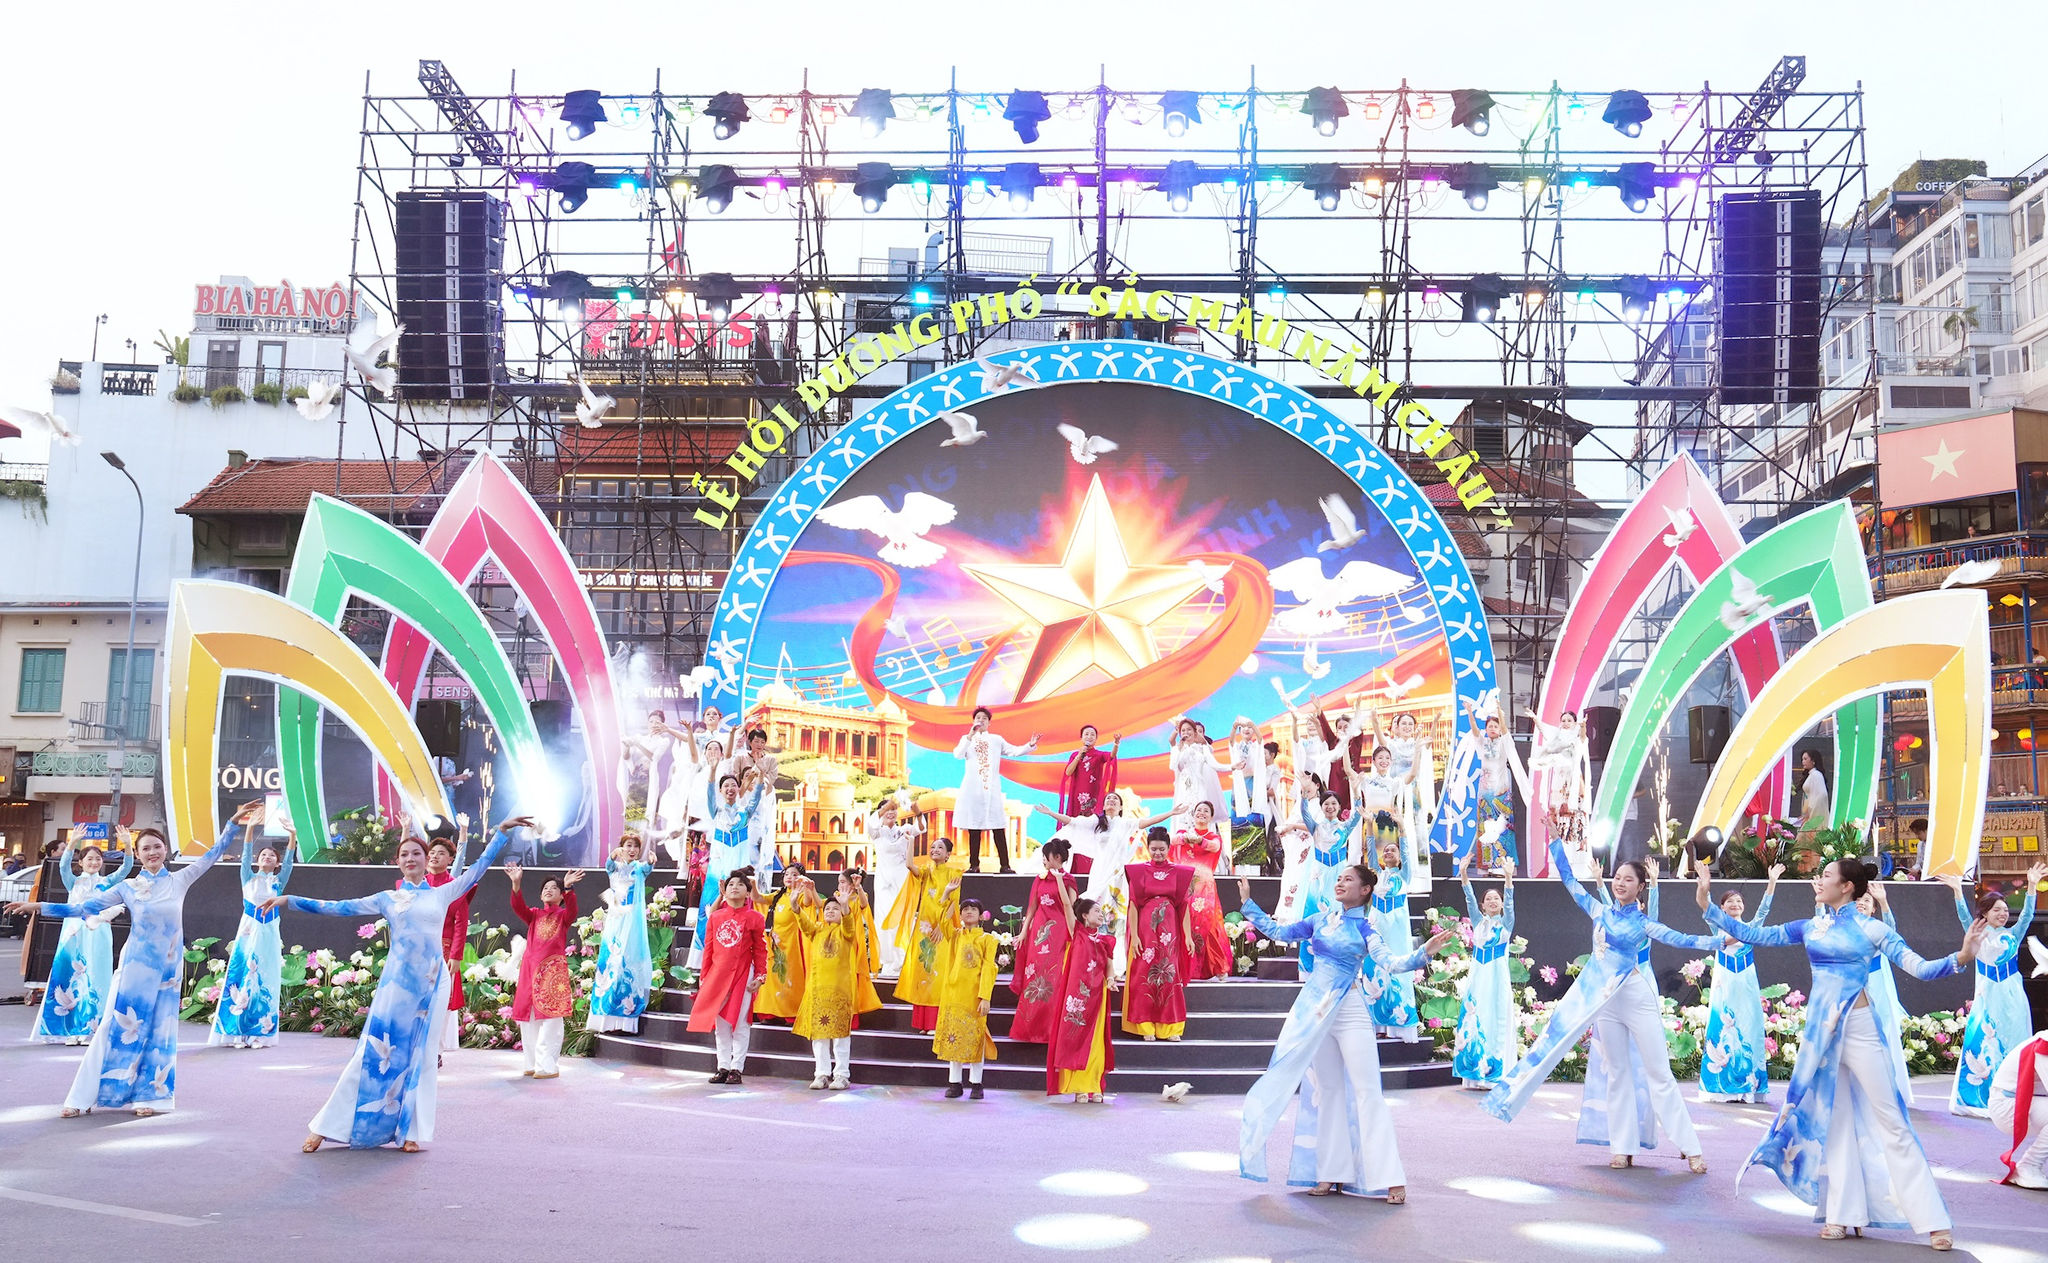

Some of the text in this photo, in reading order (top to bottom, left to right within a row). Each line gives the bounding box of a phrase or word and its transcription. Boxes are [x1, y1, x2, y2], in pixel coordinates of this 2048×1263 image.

[194, 279, 359, 326] BIA HÀ NỘI
[691, 471, 741, 532] LỄ
[725, 403, 801, 482] HỘI
[795, 312, 942, 413] ĐƯỜNG
[949, 273, 1042, 334] PHỐ
[1185, 295, 1289, 351] MÀU
[1293, 330, 1402, 410] NĂM
[218, 763, 281, 793] ỘNG
